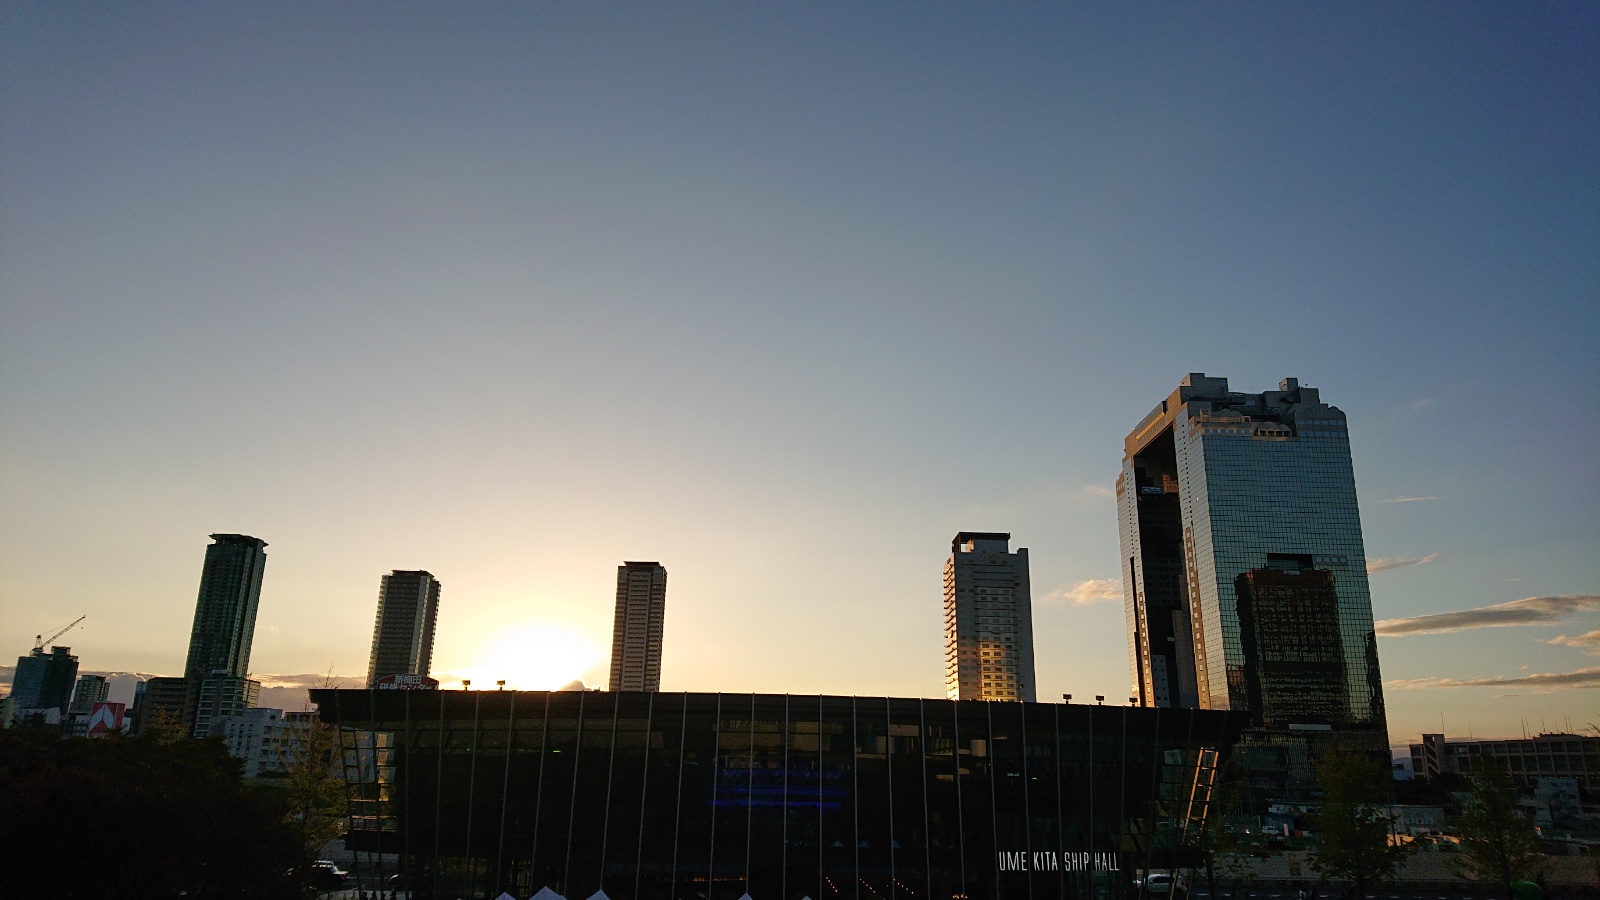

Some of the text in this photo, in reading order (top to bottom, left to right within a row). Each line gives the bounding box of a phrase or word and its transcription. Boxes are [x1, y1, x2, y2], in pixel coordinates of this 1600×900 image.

[998, 851, 1121, 871] UME KITA SHIP HALL
